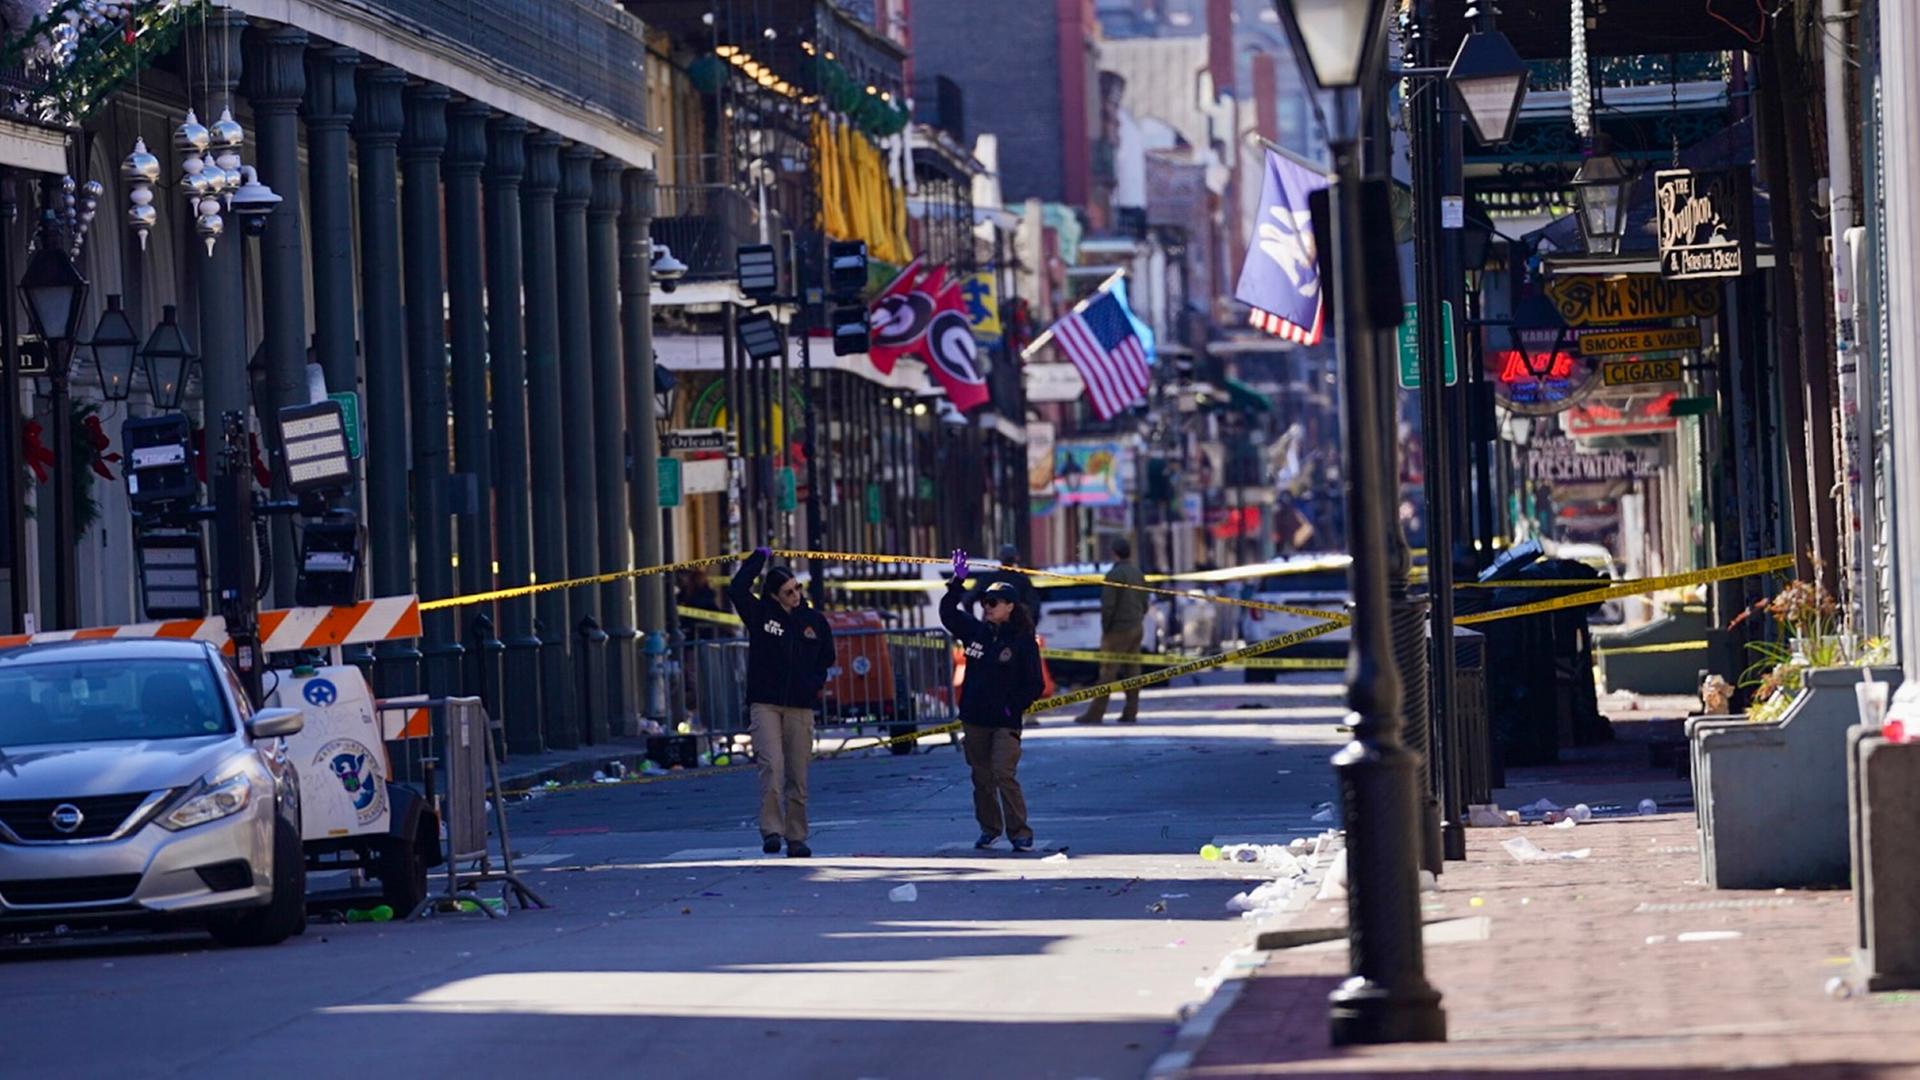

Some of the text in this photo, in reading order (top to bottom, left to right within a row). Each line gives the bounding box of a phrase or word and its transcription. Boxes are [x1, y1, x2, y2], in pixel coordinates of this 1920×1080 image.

[1674, 178, 1690, 194] THE
[1670, 252, 1679, 271] &
[1596, 276, 1680, 317] RA SHOP
[1521, 329, 1574, 343] KARAOE
[1585, 335, 1638, 352] SMOKE
[1642, 335, 1652, 347] &
[1656, 331, 1698, 347] VAPE
[1611, 363, 1675, 381] CIGARS
[671, 436, 722, 448] Orleans
[764, 623, 784, 636] ERT
[1295, 626, 1315, 641] LINE
[1314, 621, 1343, 637] POLICE
[1264, 637, 1283, 650] NOT
[1282, 634, 1294, 645] DO
[964, 647, 984, 659] ERT
[1167, 668, 1179, 679] DO
[1180, 662, 1199, 675] LINE
[1121, 676, 1149, 692] CROSS
[1149, 672, 1166, 684] NOT
[1062, 692, 1083, 705] LINE
[1083, 686, 1112, 700] POLICE
[1033, 700, 1051, 713] NOT
[1051, 698, 1063, 708] DO
